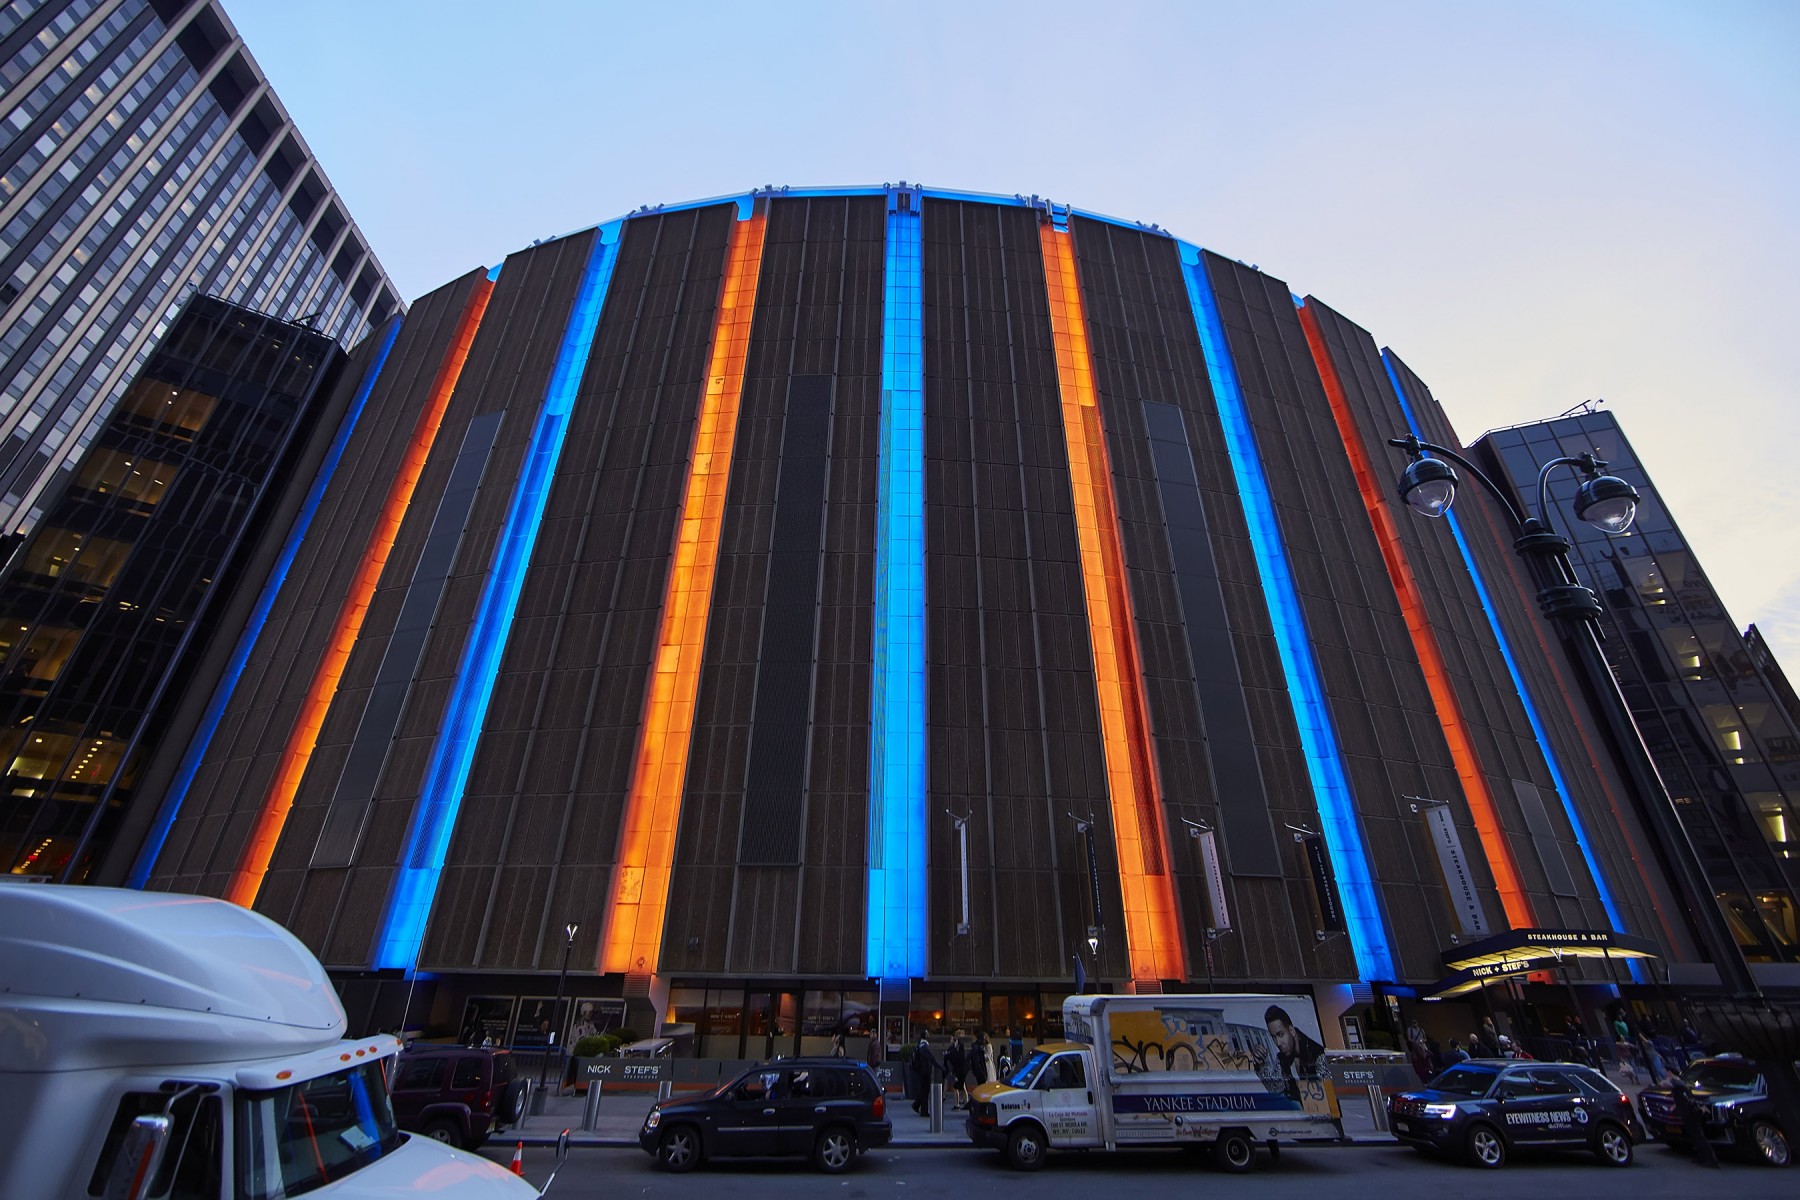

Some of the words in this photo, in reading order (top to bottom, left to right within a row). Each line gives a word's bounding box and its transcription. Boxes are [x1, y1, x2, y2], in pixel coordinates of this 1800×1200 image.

[1450, 849, 1472, 901] STEAKHOUSE
[1472, 914, 1481, 931] BAR
[1527, 933, 1578, 941] STEAKHOUSE
[1472, 966, 1493, 977] NICK
[1502, 960, 1530, 973] STEF'S
[587, 1065, 612, 1074] NICK
[624, 1065, 659, 1075] STEF'S
[1343, 1071, 1374, 1079] STEF'S
[1143, 1096, 1194, 1112] YANKEE
[1196, 1095, 1256, 1111] STADIUM
[1505, 1111, 1550, 1125] EYEWITNESS
[1549, 1110, 1572, 1123] NEWS
